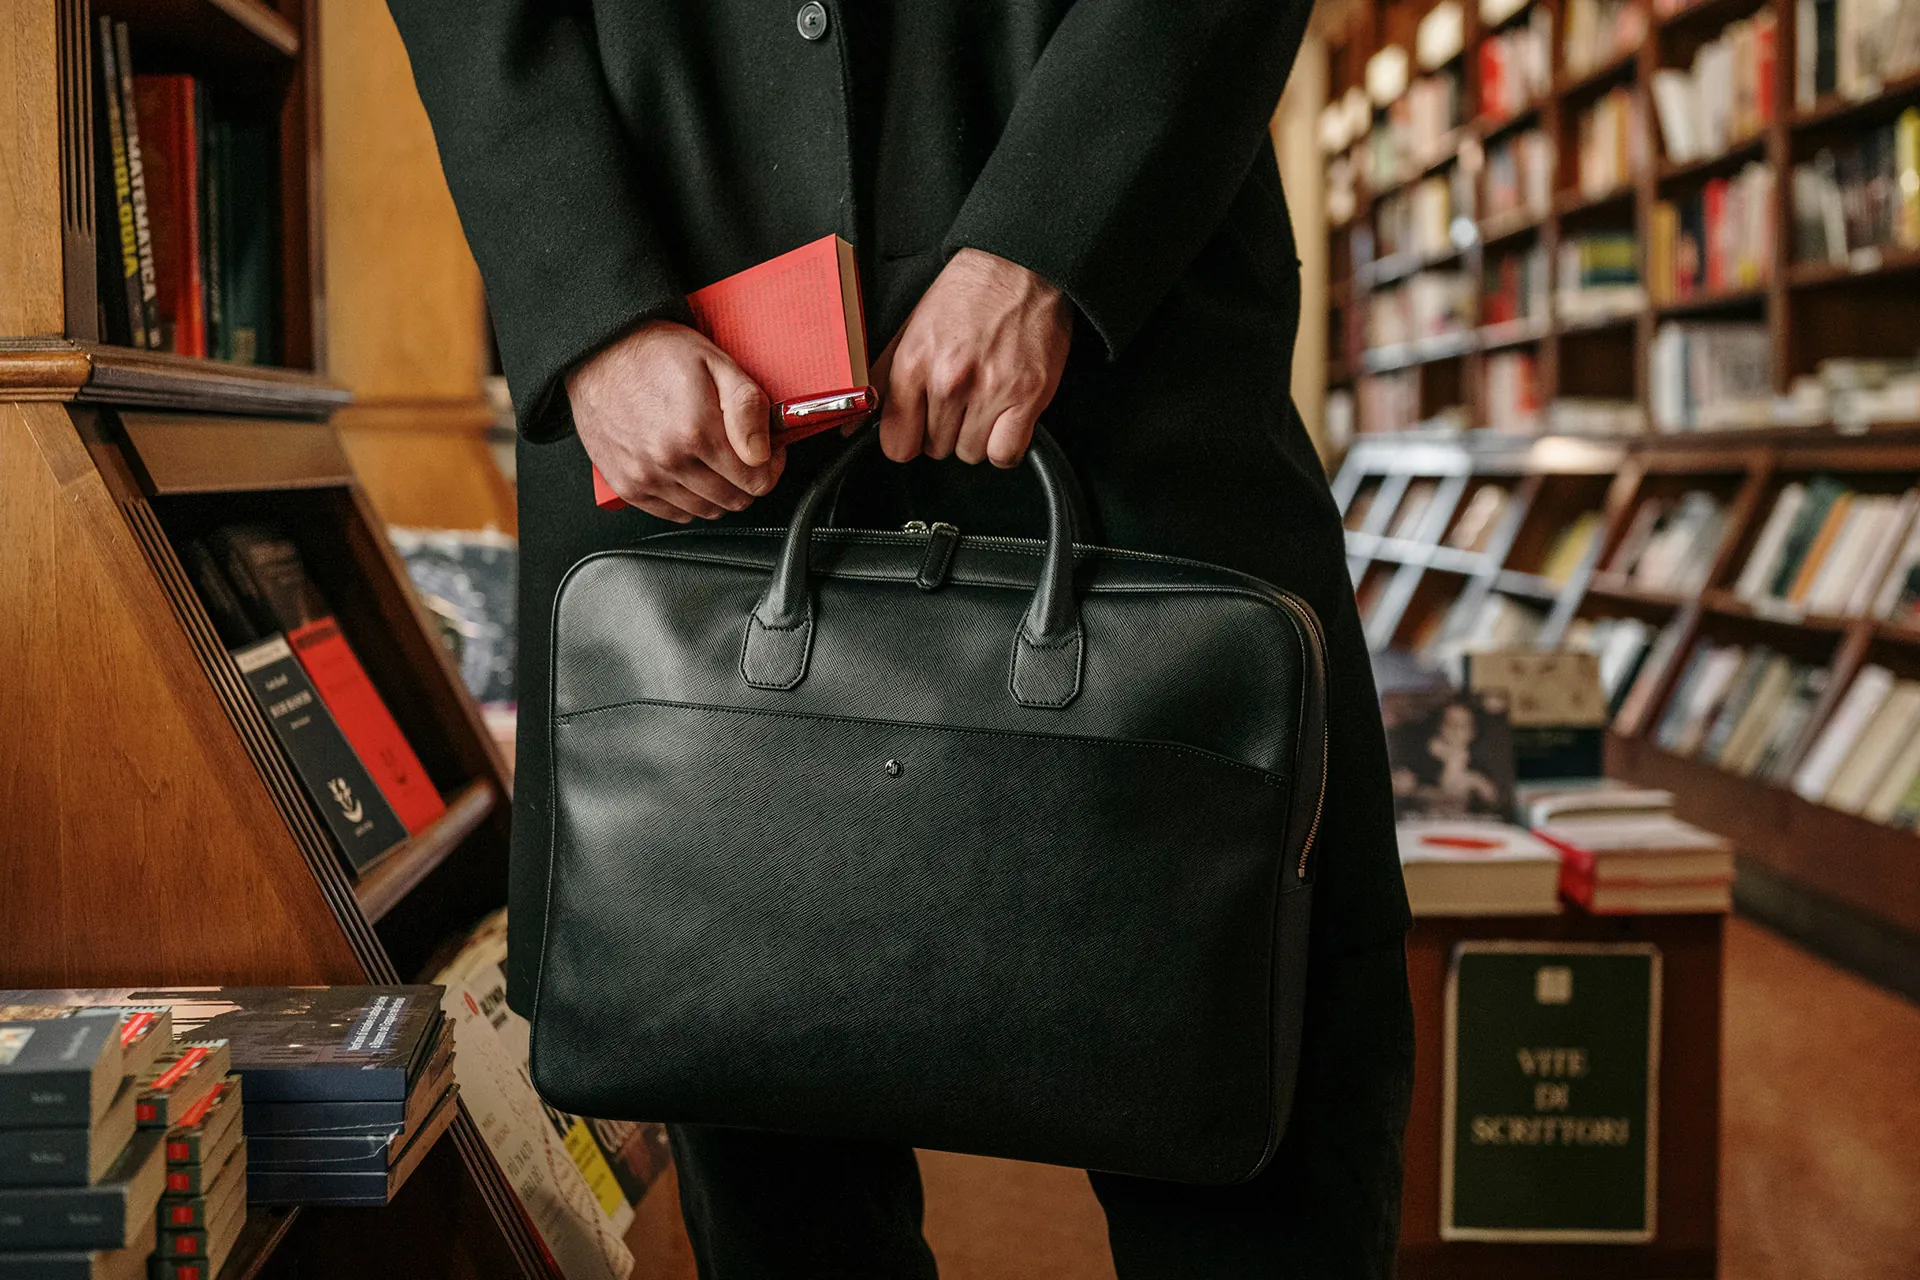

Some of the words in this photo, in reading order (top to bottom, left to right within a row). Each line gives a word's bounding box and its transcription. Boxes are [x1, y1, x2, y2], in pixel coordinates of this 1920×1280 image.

[127, 134, 157, 301] MATEMATICA
[1516, 1047, 1588, 1077] VITE
[1534, 1083, 1569, 1112] DI
[1472, 1115, 1630, 1145] SCRITTORI
